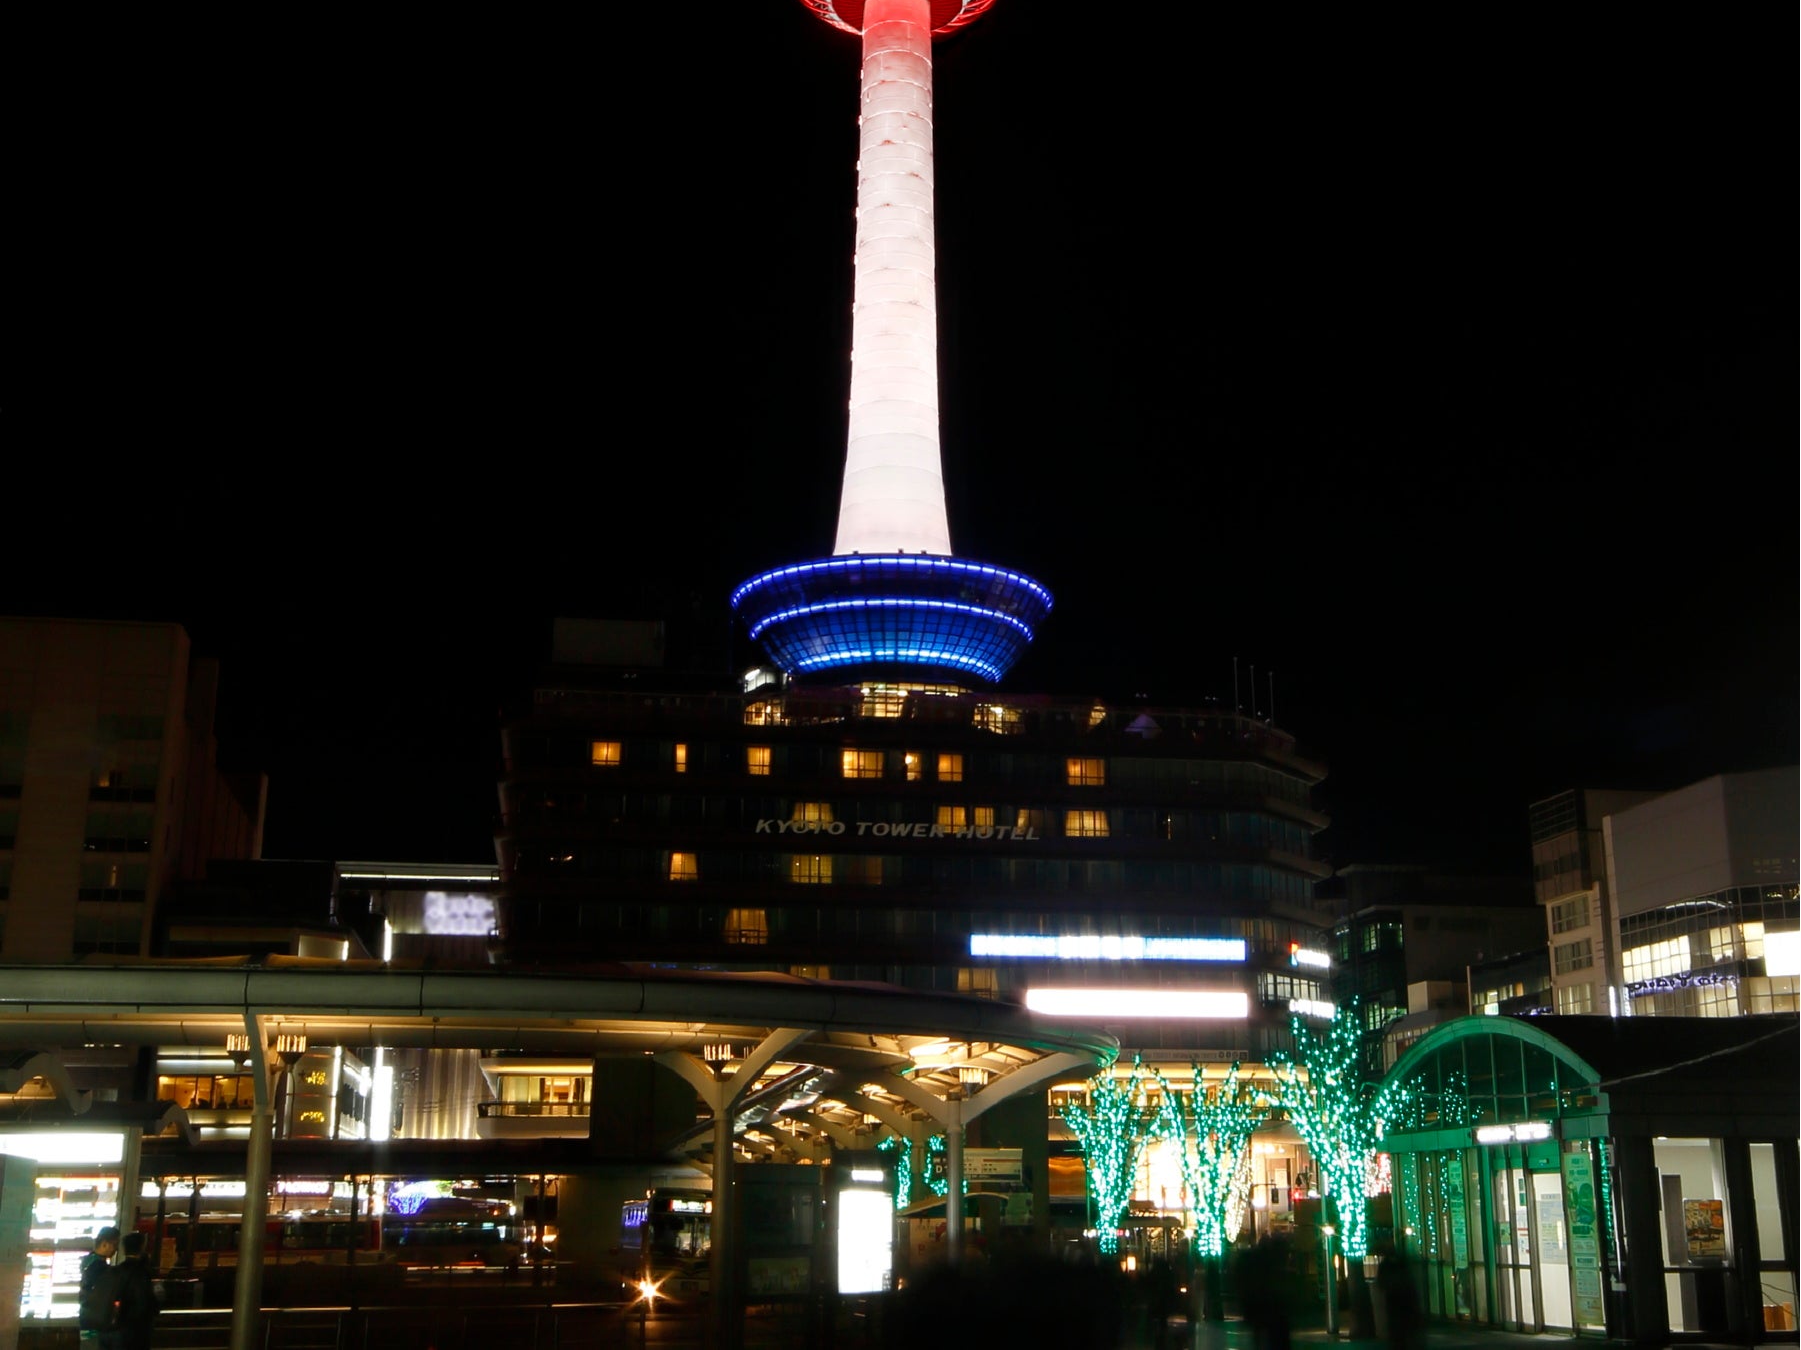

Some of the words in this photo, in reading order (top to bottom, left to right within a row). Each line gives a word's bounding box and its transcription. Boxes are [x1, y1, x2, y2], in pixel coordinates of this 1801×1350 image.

[754, 818, 847, 836] KYOTO
[855, 821, 945, 838] TOWER
[955, 825, 1041, 841] HOTEL
